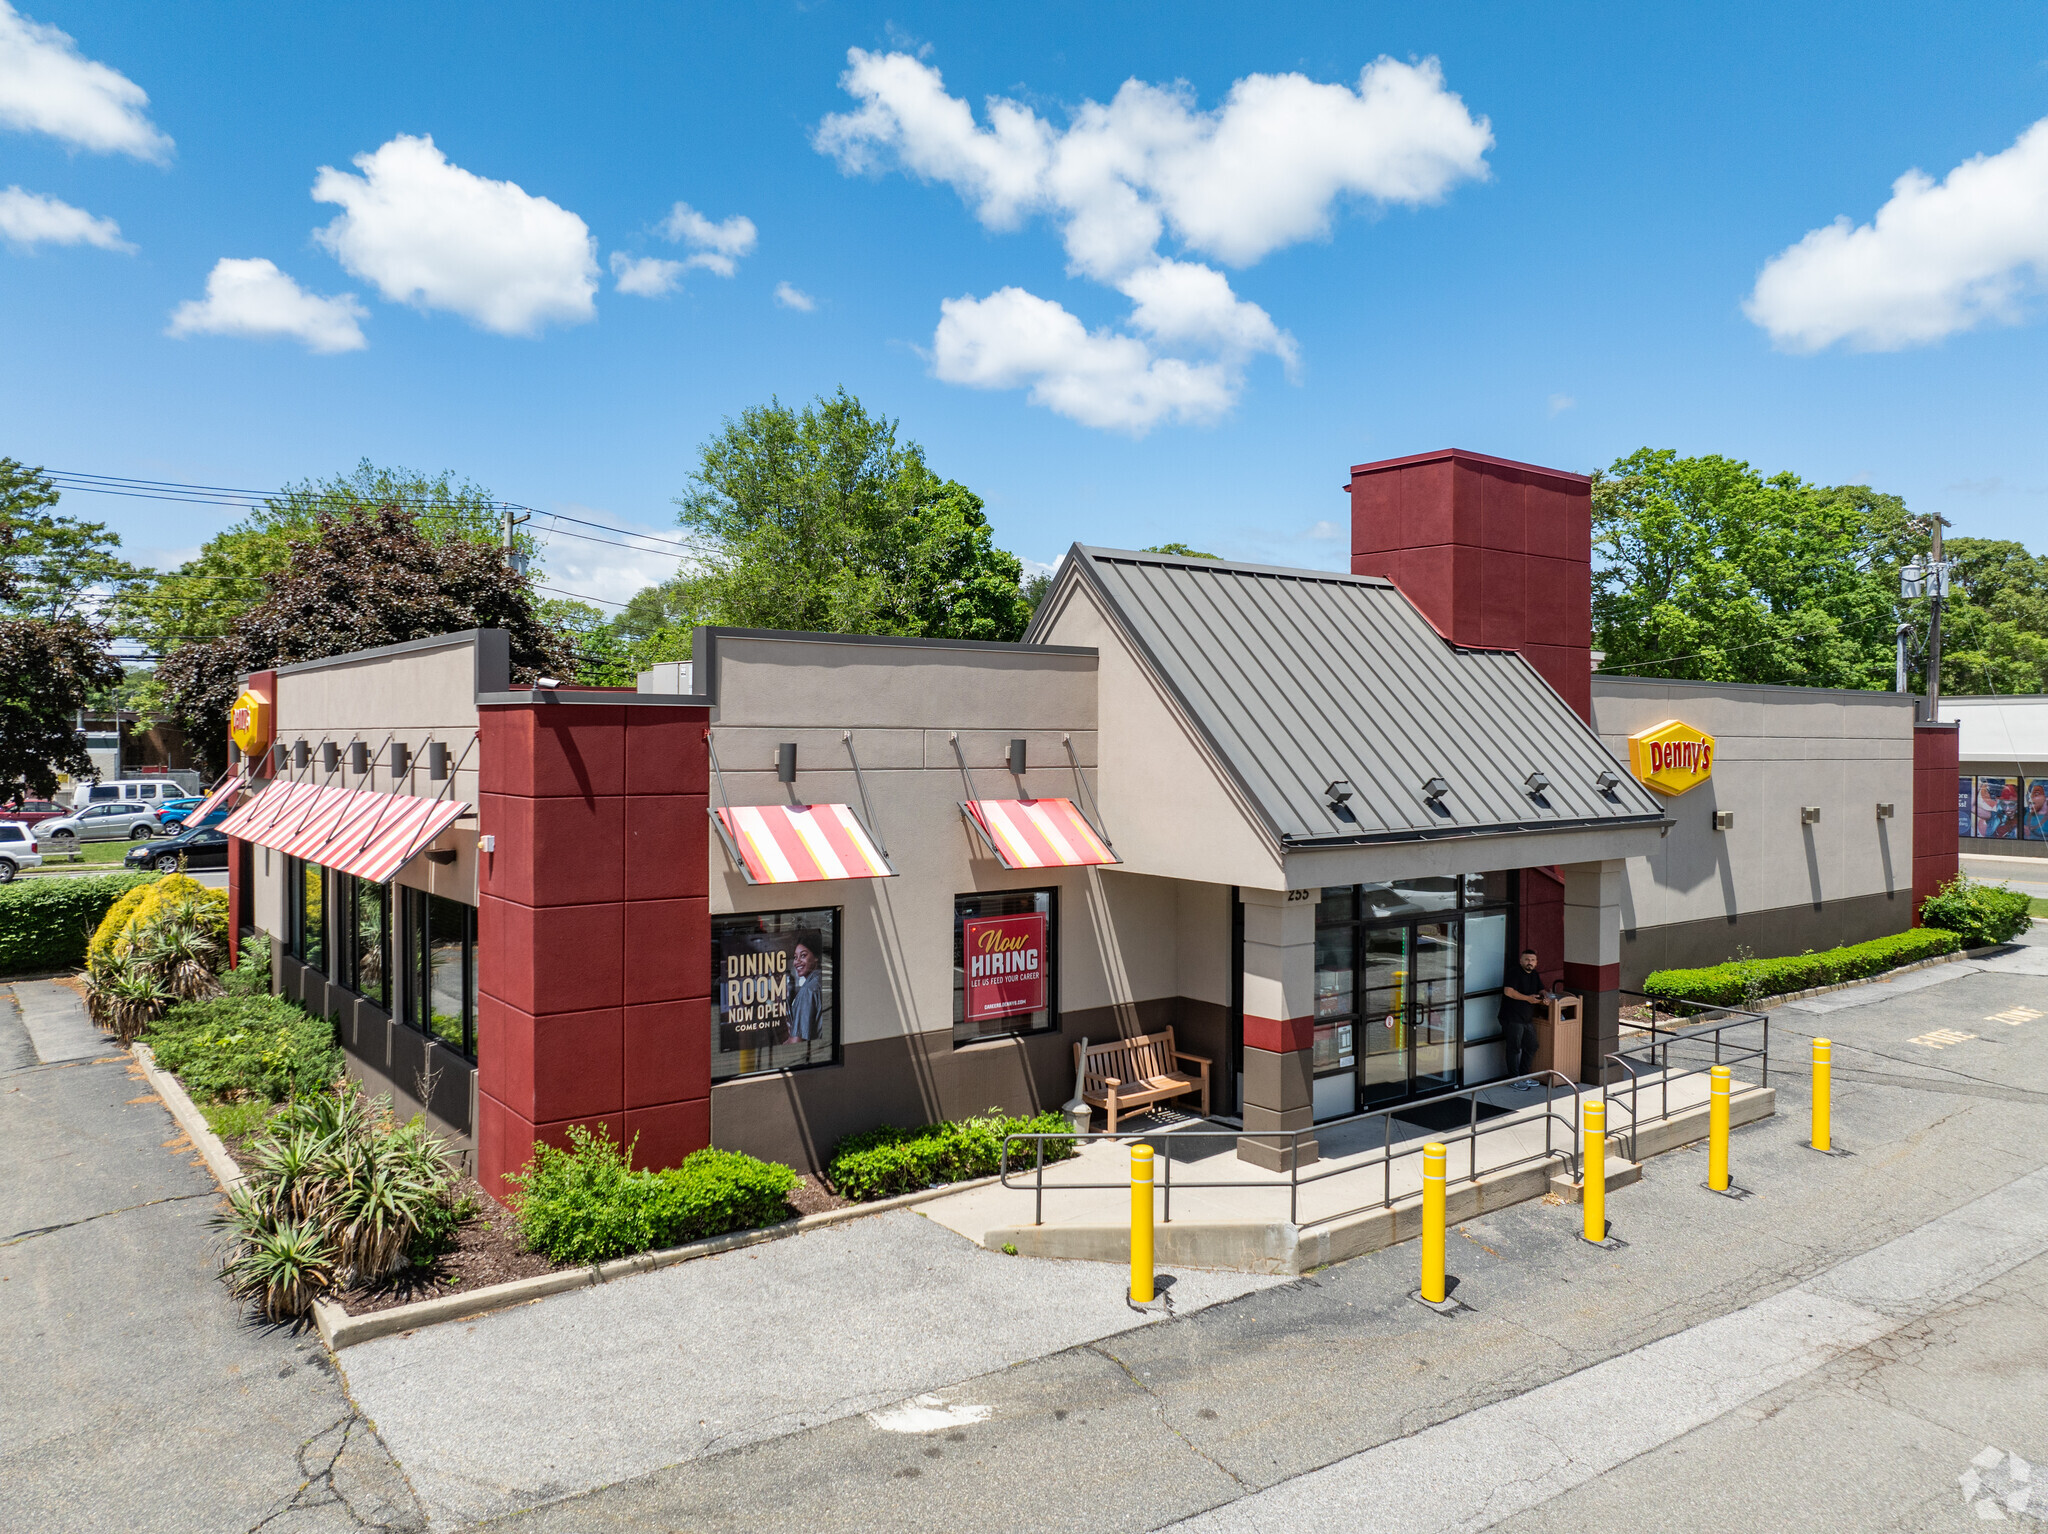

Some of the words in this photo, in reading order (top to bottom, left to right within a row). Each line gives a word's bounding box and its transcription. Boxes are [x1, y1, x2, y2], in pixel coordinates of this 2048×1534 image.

[1648, 737, 1711, 775] Denny's
[1288, 889, 1309, 901] 255
[978, 929, 1029, 953] Now
[728, 951, 787, 978] DINING
[972, 949, 1038, 978] HIRING
[728, 974, 787, 1007] ROOM
[971, 980, 981, 988] LET
[982, 978, 990, 986] US
[990, 976, 1004, 985] FEED
[1005, 974, 1019, 983] YOUR
[1020, 971, 1040, 981] CAREER
[728, 1006, 754, 1024] NOW
[757, 1001, 787, 1020] OPEN
[735, 1022, 757, 1033] COME
[758, 1020, 770, 1029] ON
